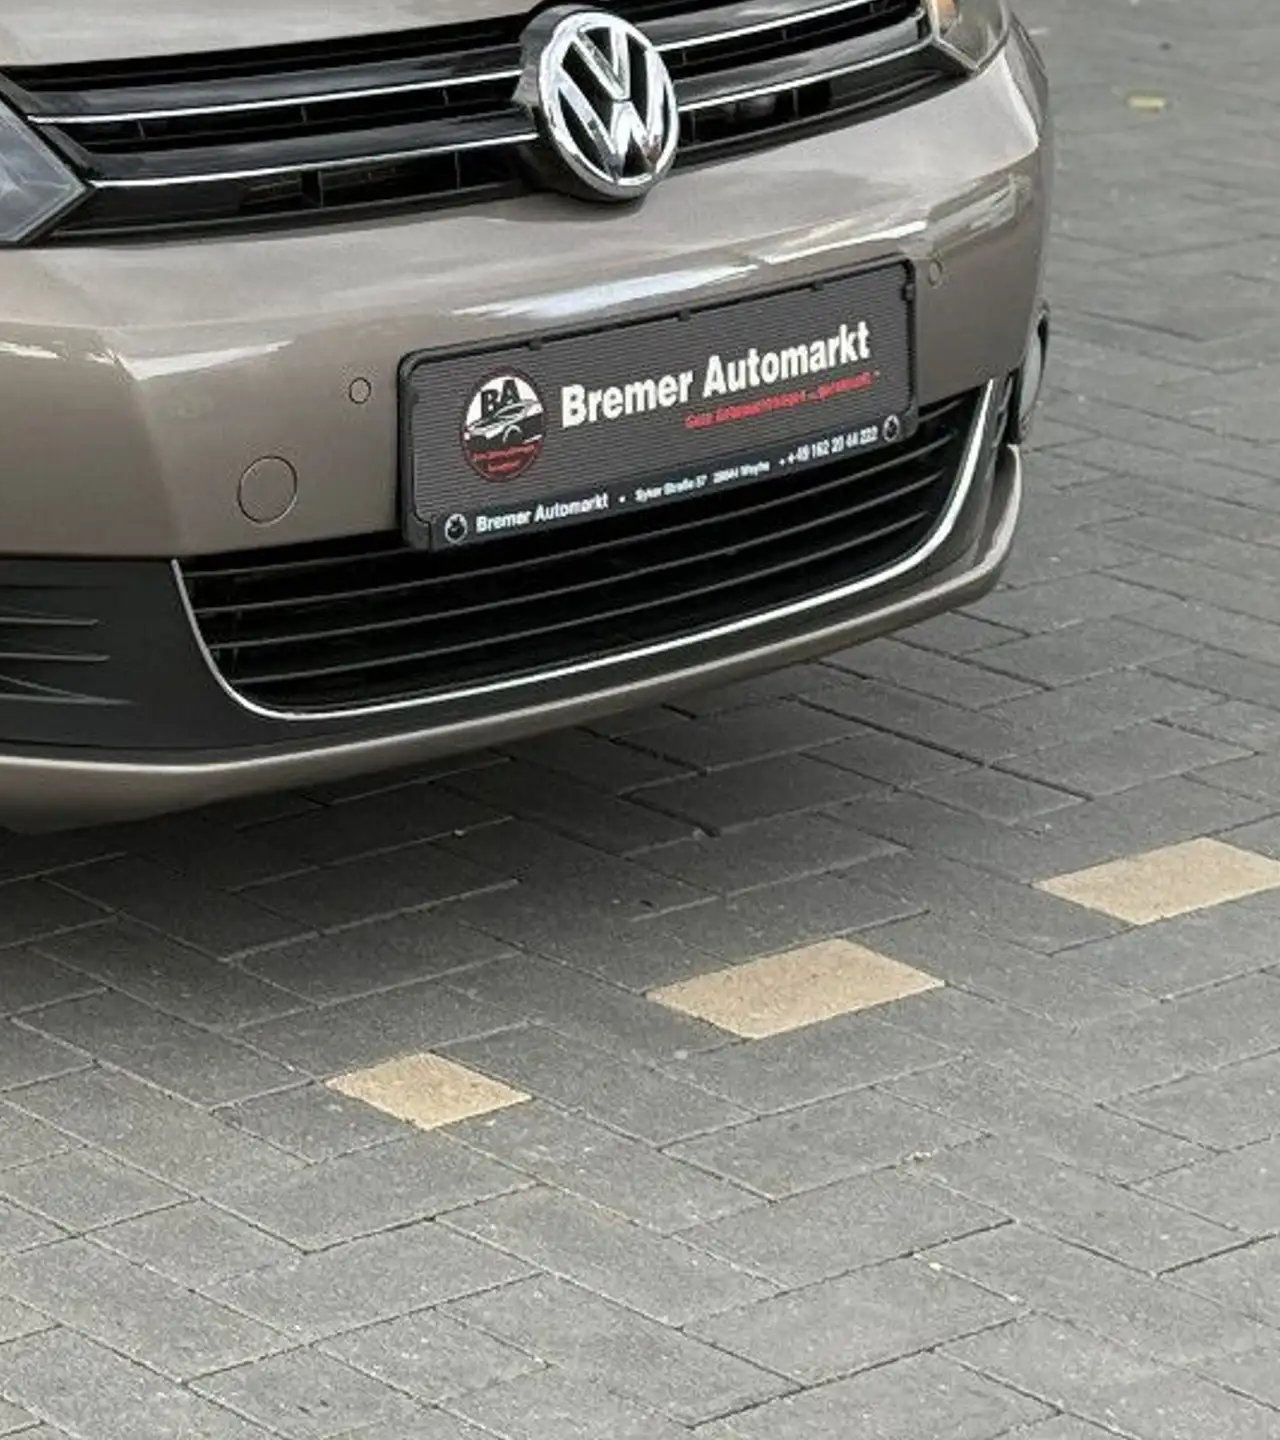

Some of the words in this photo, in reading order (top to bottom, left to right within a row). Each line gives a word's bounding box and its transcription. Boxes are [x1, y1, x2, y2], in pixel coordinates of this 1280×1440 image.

[561, 370, 693, 428] Bremer
[702, 321, 871, 399] Automarkt
[476, 510, 532, 533] Bremer
[533, 492, 609, 522] Automarkt
